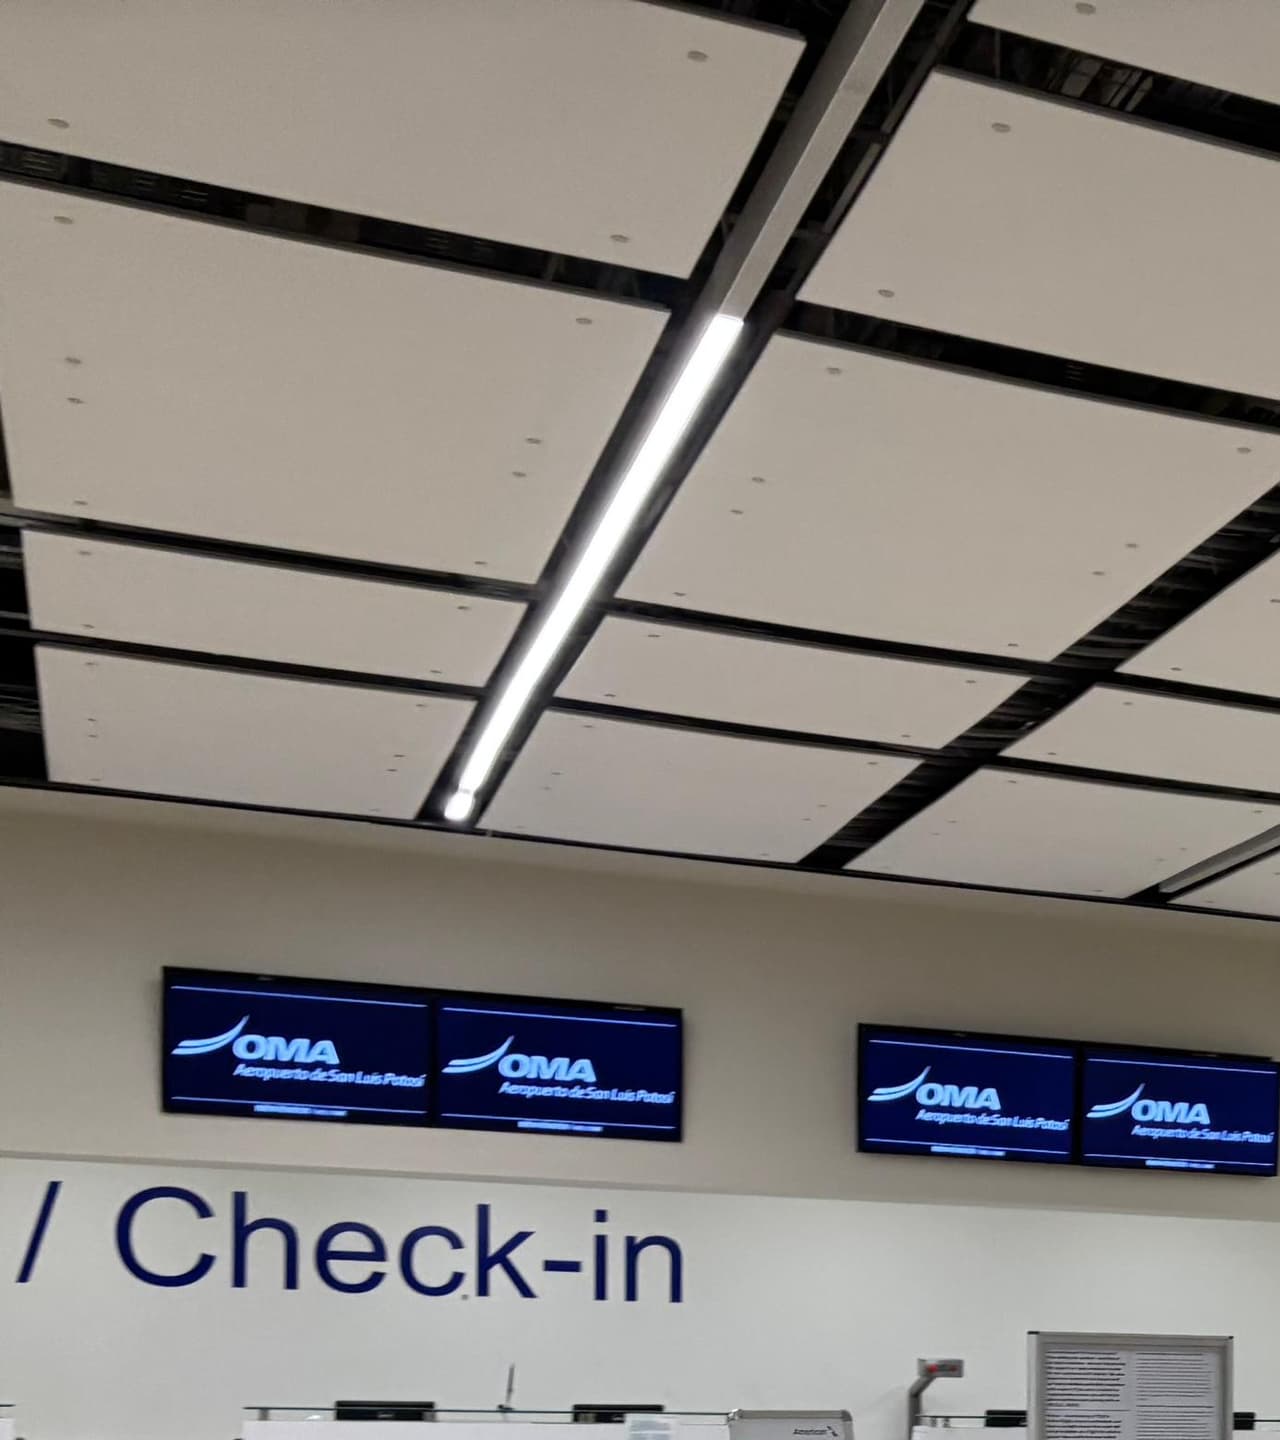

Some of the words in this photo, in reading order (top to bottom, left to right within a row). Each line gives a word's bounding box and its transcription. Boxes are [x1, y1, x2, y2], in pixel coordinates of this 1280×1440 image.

[232, 1034, 340, 1064] OMA
[233, 1063, 308, 1081] Aeropuerto
[498, 1053, 597, 1082] OMA
[498, 1081, 569, 1099] Aeropuerto
[915, 1082, 1001, 1111] OMA
[1131, 1099, 1211, 1125] OMA
[16, 1181, 62, 1283] /
[115, 1185, 684, 1303] Check-in
